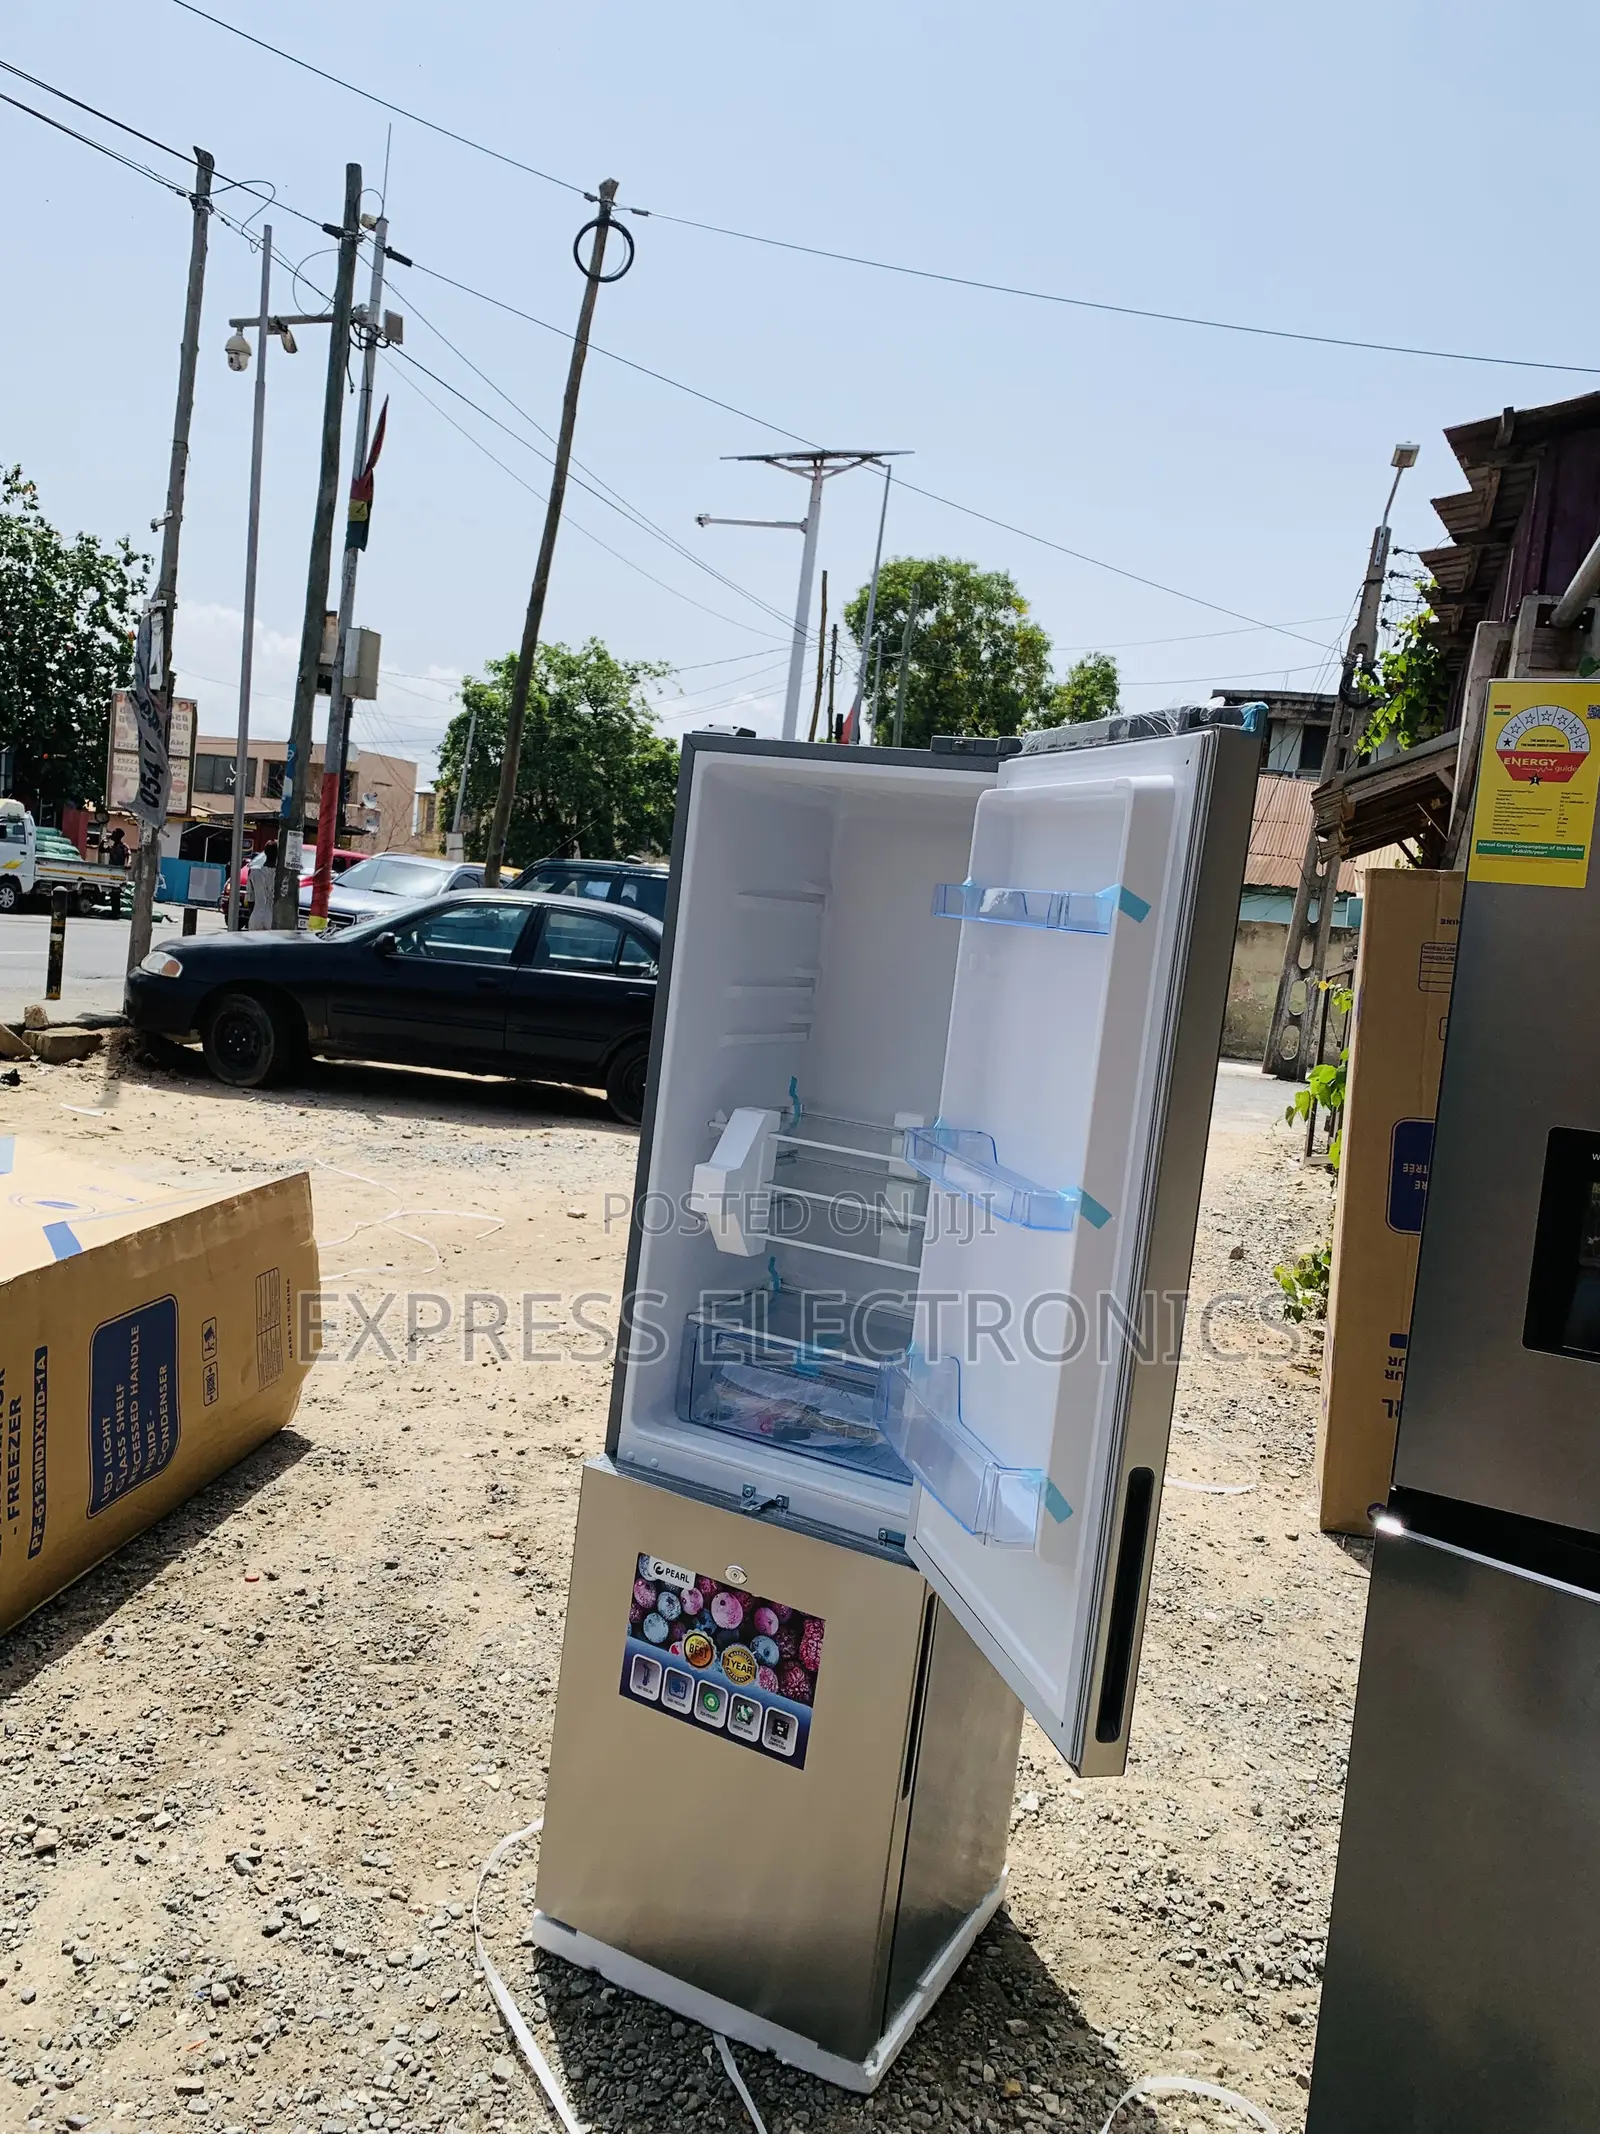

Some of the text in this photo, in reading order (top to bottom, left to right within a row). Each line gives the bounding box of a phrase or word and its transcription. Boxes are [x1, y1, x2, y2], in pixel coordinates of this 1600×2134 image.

[1554, 765, 1579, 773] guide
[115, 1383, 128, 1493] GLASS SHELF
[128, 1324, 141, 1484] RECESSED HANDLE
[157, 1363, 169, 1466] CONDENSER
[8, 1394, 22, 1522] FREEZER
[31, 1355, 47, 1551] PF-613MDIXWD-1A
[101, 1416, 114, 1503] LED LIGHT
[142, 1417, 157, 1480] INSIDE
[665, 1567, 690, 1584] PEARL
[689, 1643, 709, 1659] BEST
[731, 1660, 753, 1675] YEAR
